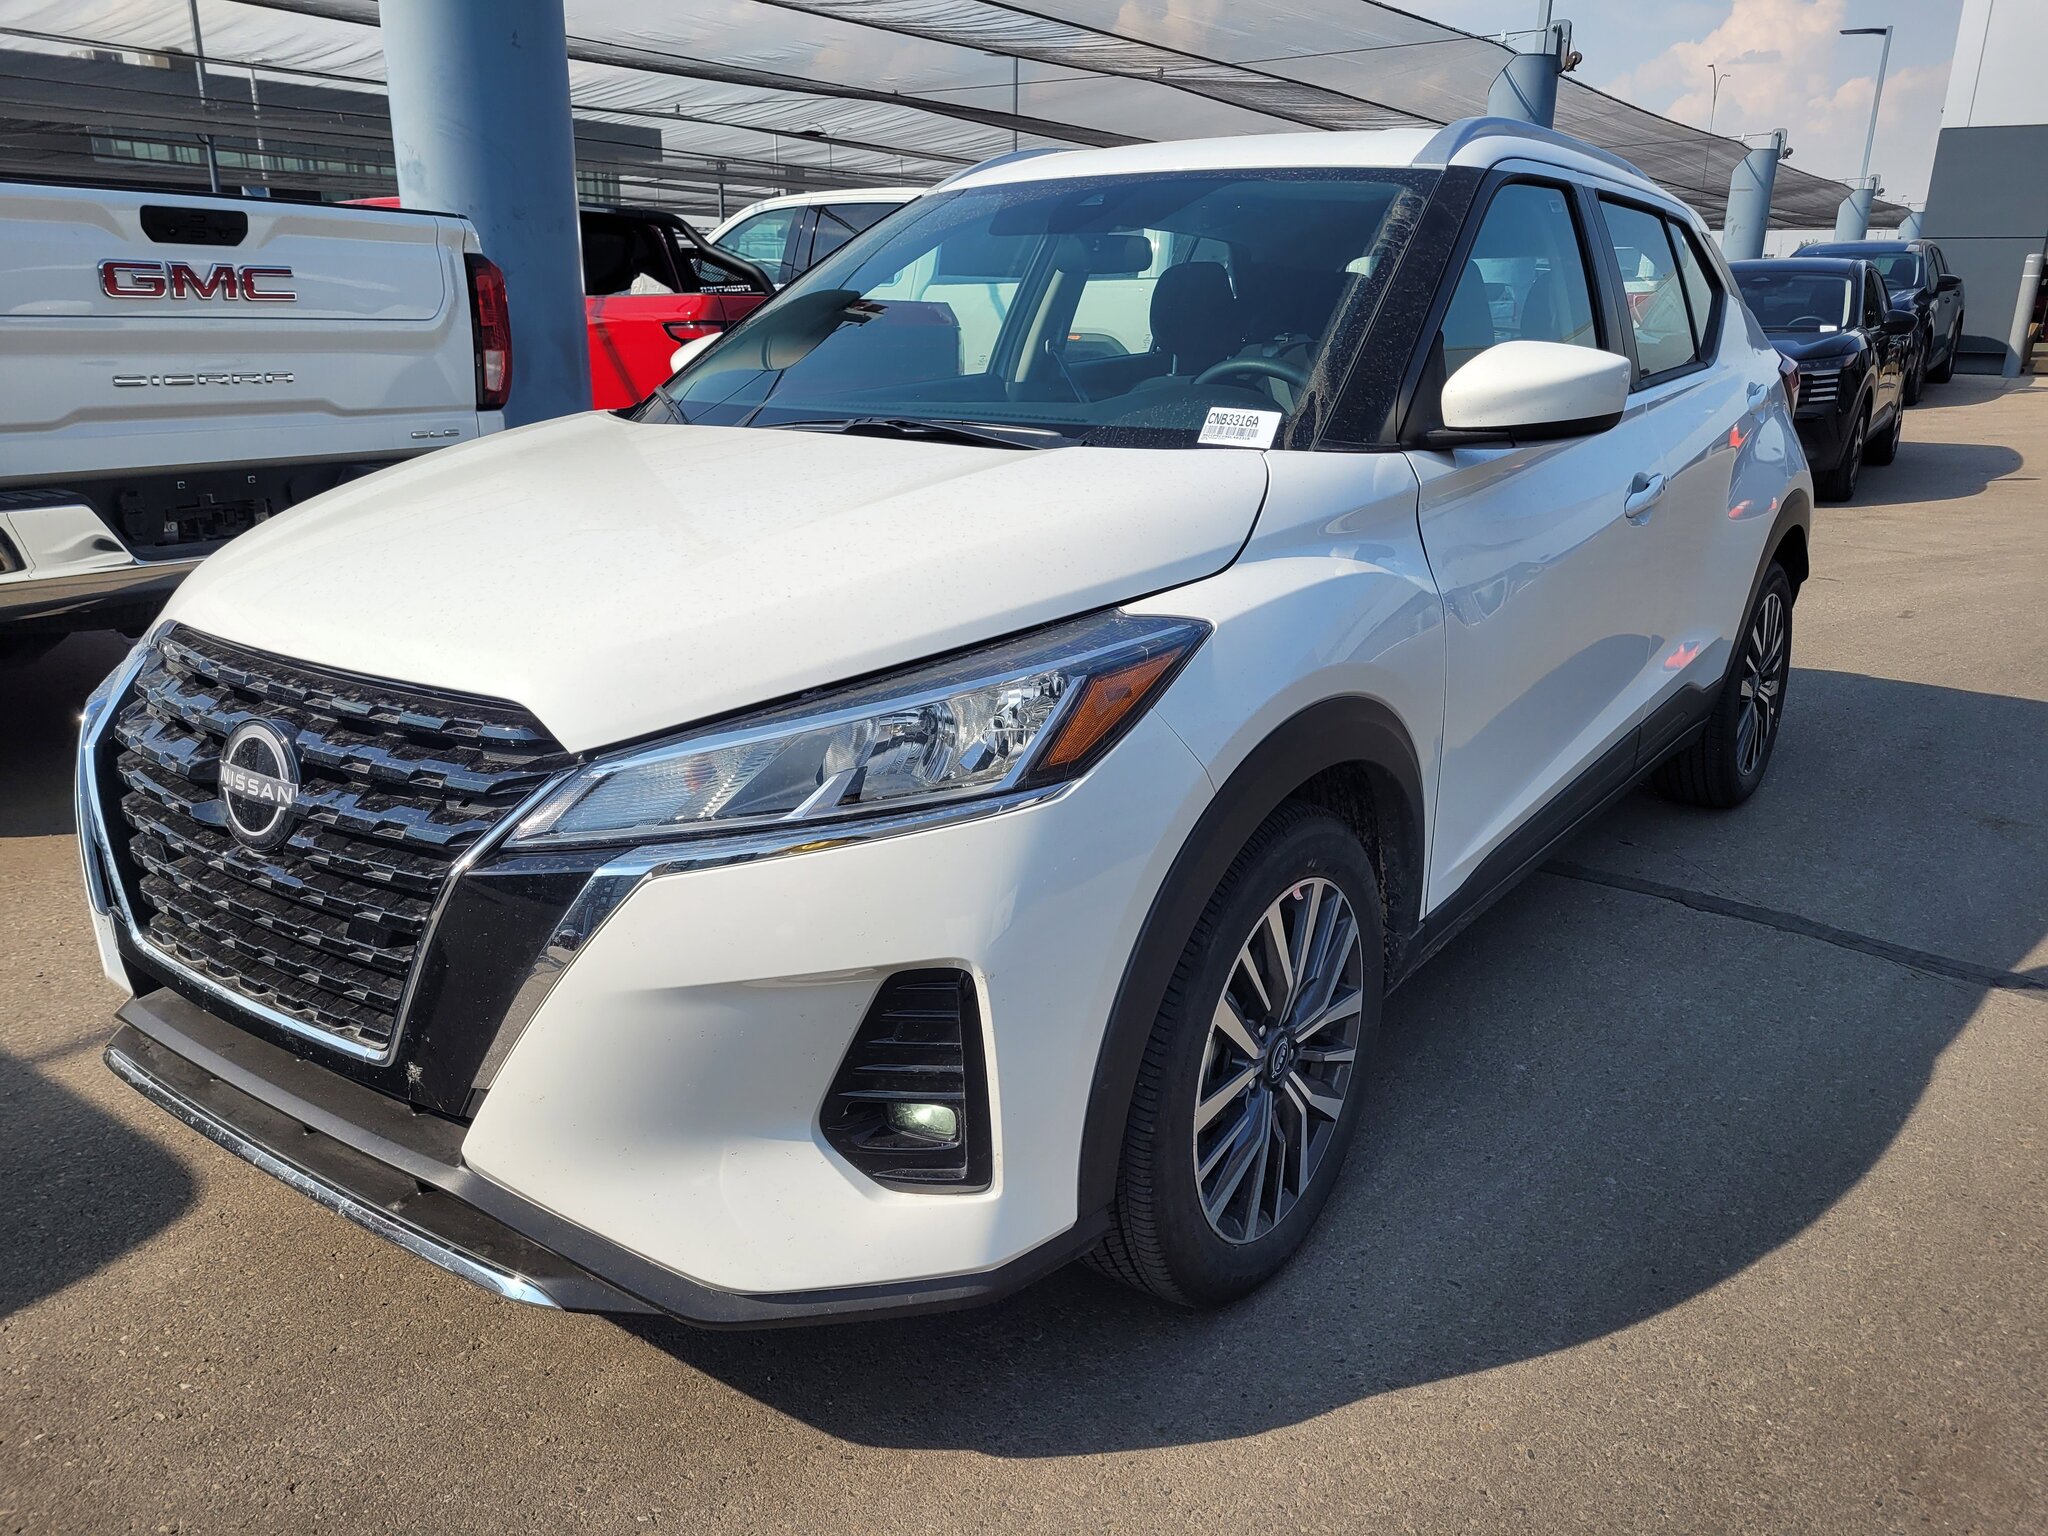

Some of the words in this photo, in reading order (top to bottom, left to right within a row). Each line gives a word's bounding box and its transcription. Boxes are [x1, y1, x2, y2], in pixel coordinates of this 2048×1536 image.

[97, 258, 298, 301] GMC
[112, 371, 295, 387] SIERRA
[1207, 412, 1260, 428] CNB3316A
[220, 765, 294, 805] NISSAN
